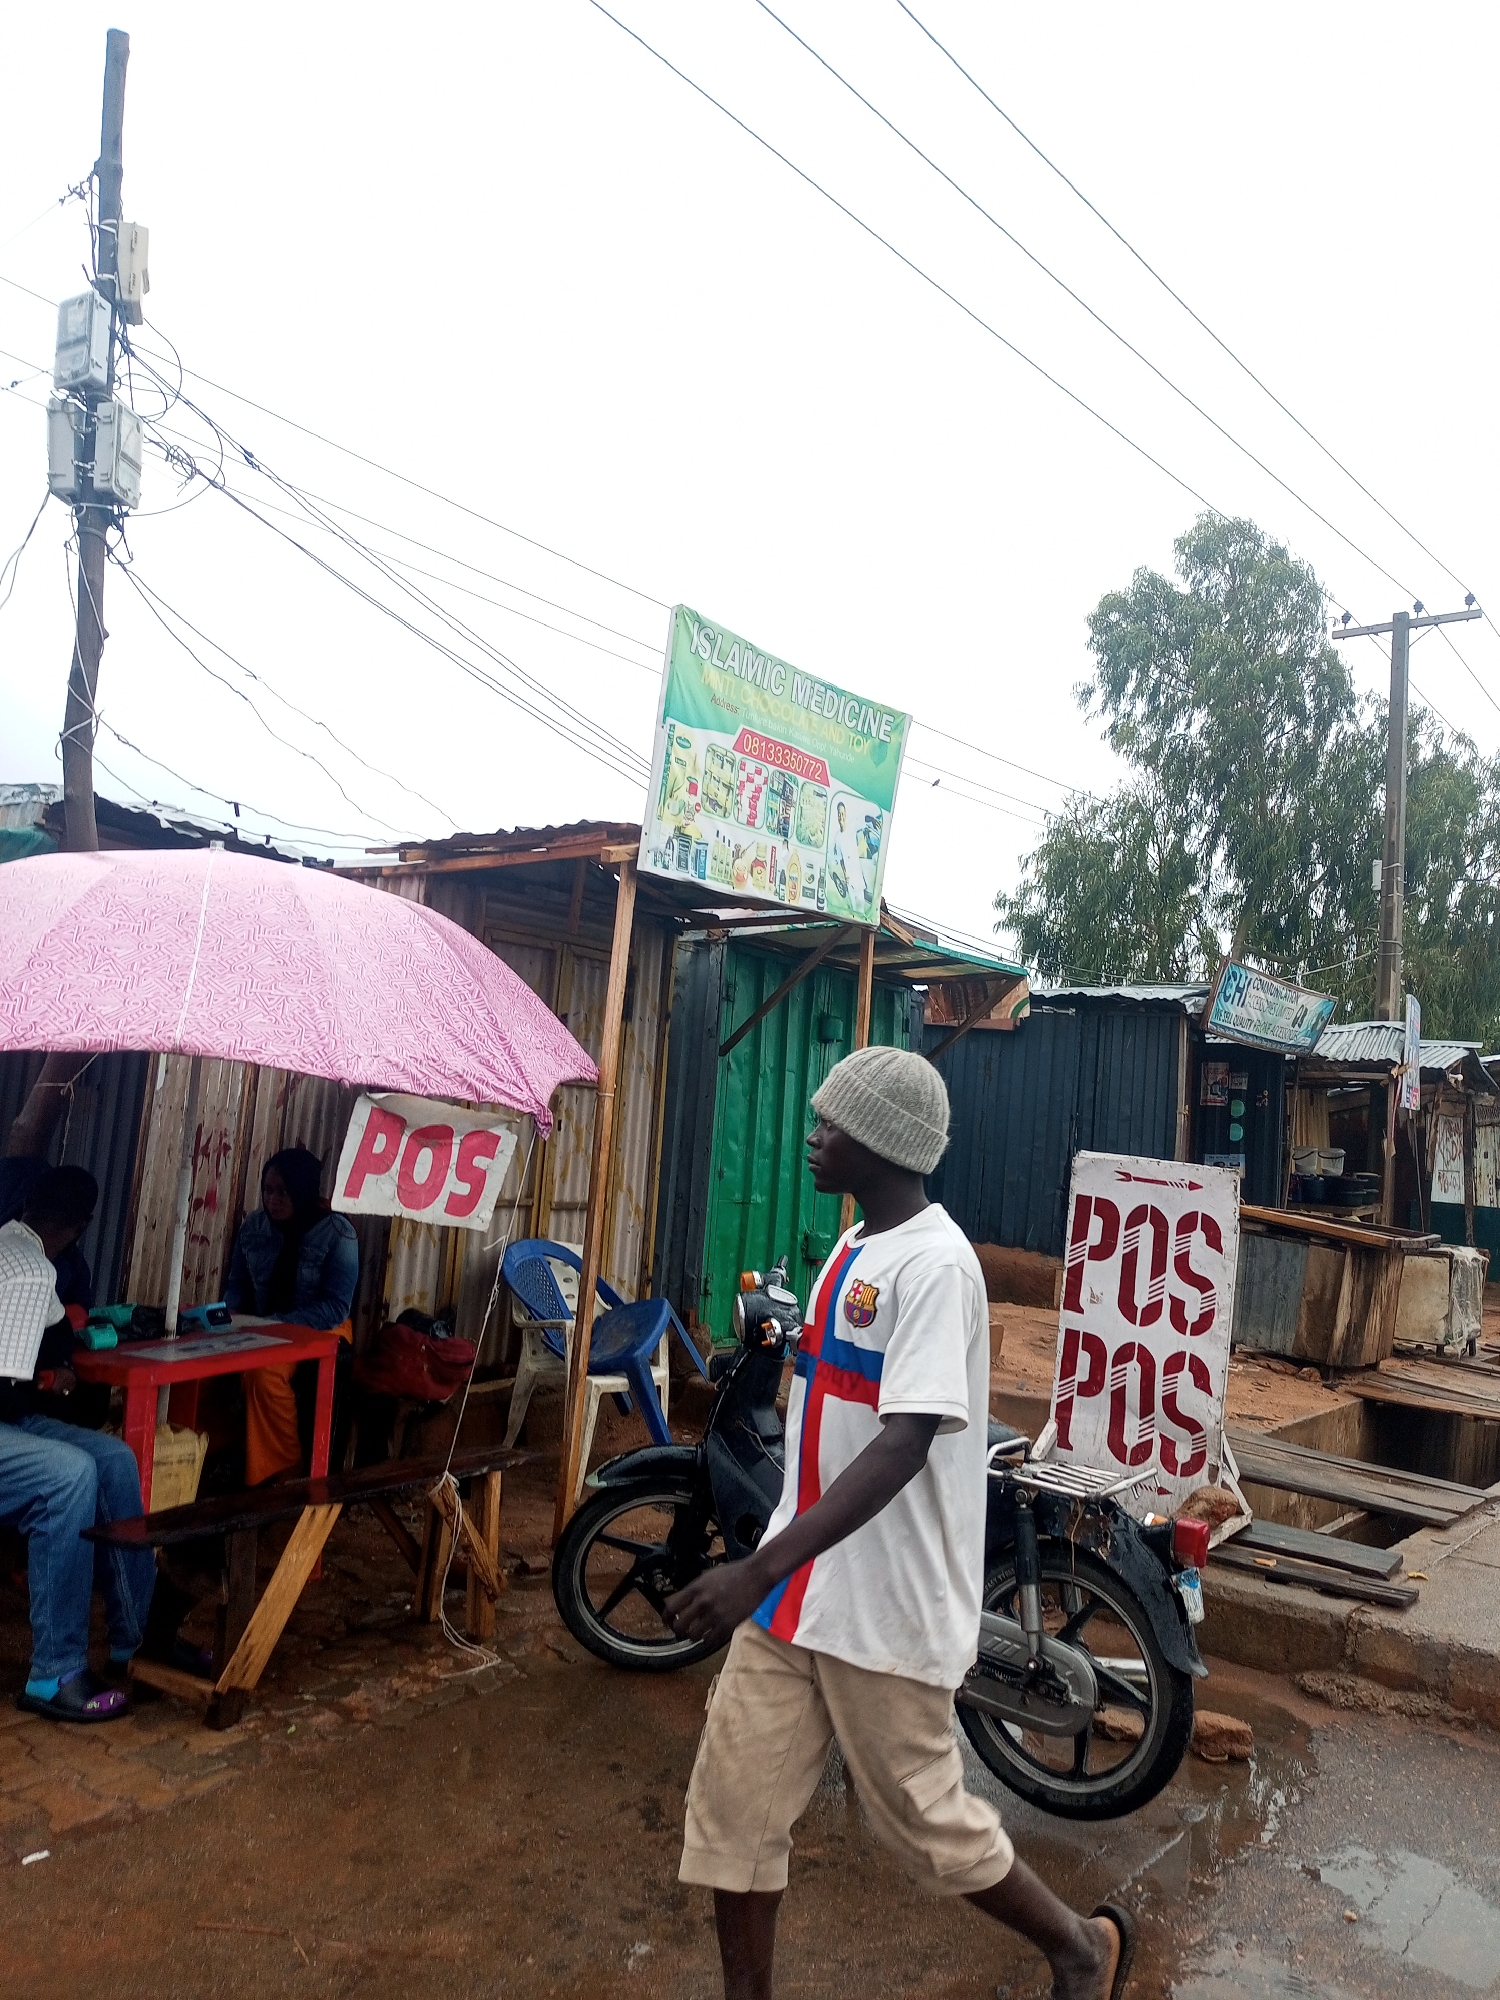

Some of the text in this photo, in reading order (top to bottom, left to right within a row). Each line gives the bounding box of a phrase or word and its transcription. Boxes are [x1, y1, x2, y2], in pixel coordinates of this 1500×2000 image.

[690, 620, 895, 743] ISLAMIC MEDICINE
[711, 693, 740, 715] Address:
[741, 684, 818, 733] CHOCOLATE
[820, 723, 846, 745] AND
[849, 732, 872, 755] TOY
[743, 733, 823, 780] 08133350772
[343, 1106, 501, 1218] POS
[1063, 1194, 1223, 1336] POS
[1055, 1328, 1212, 1477] POS
